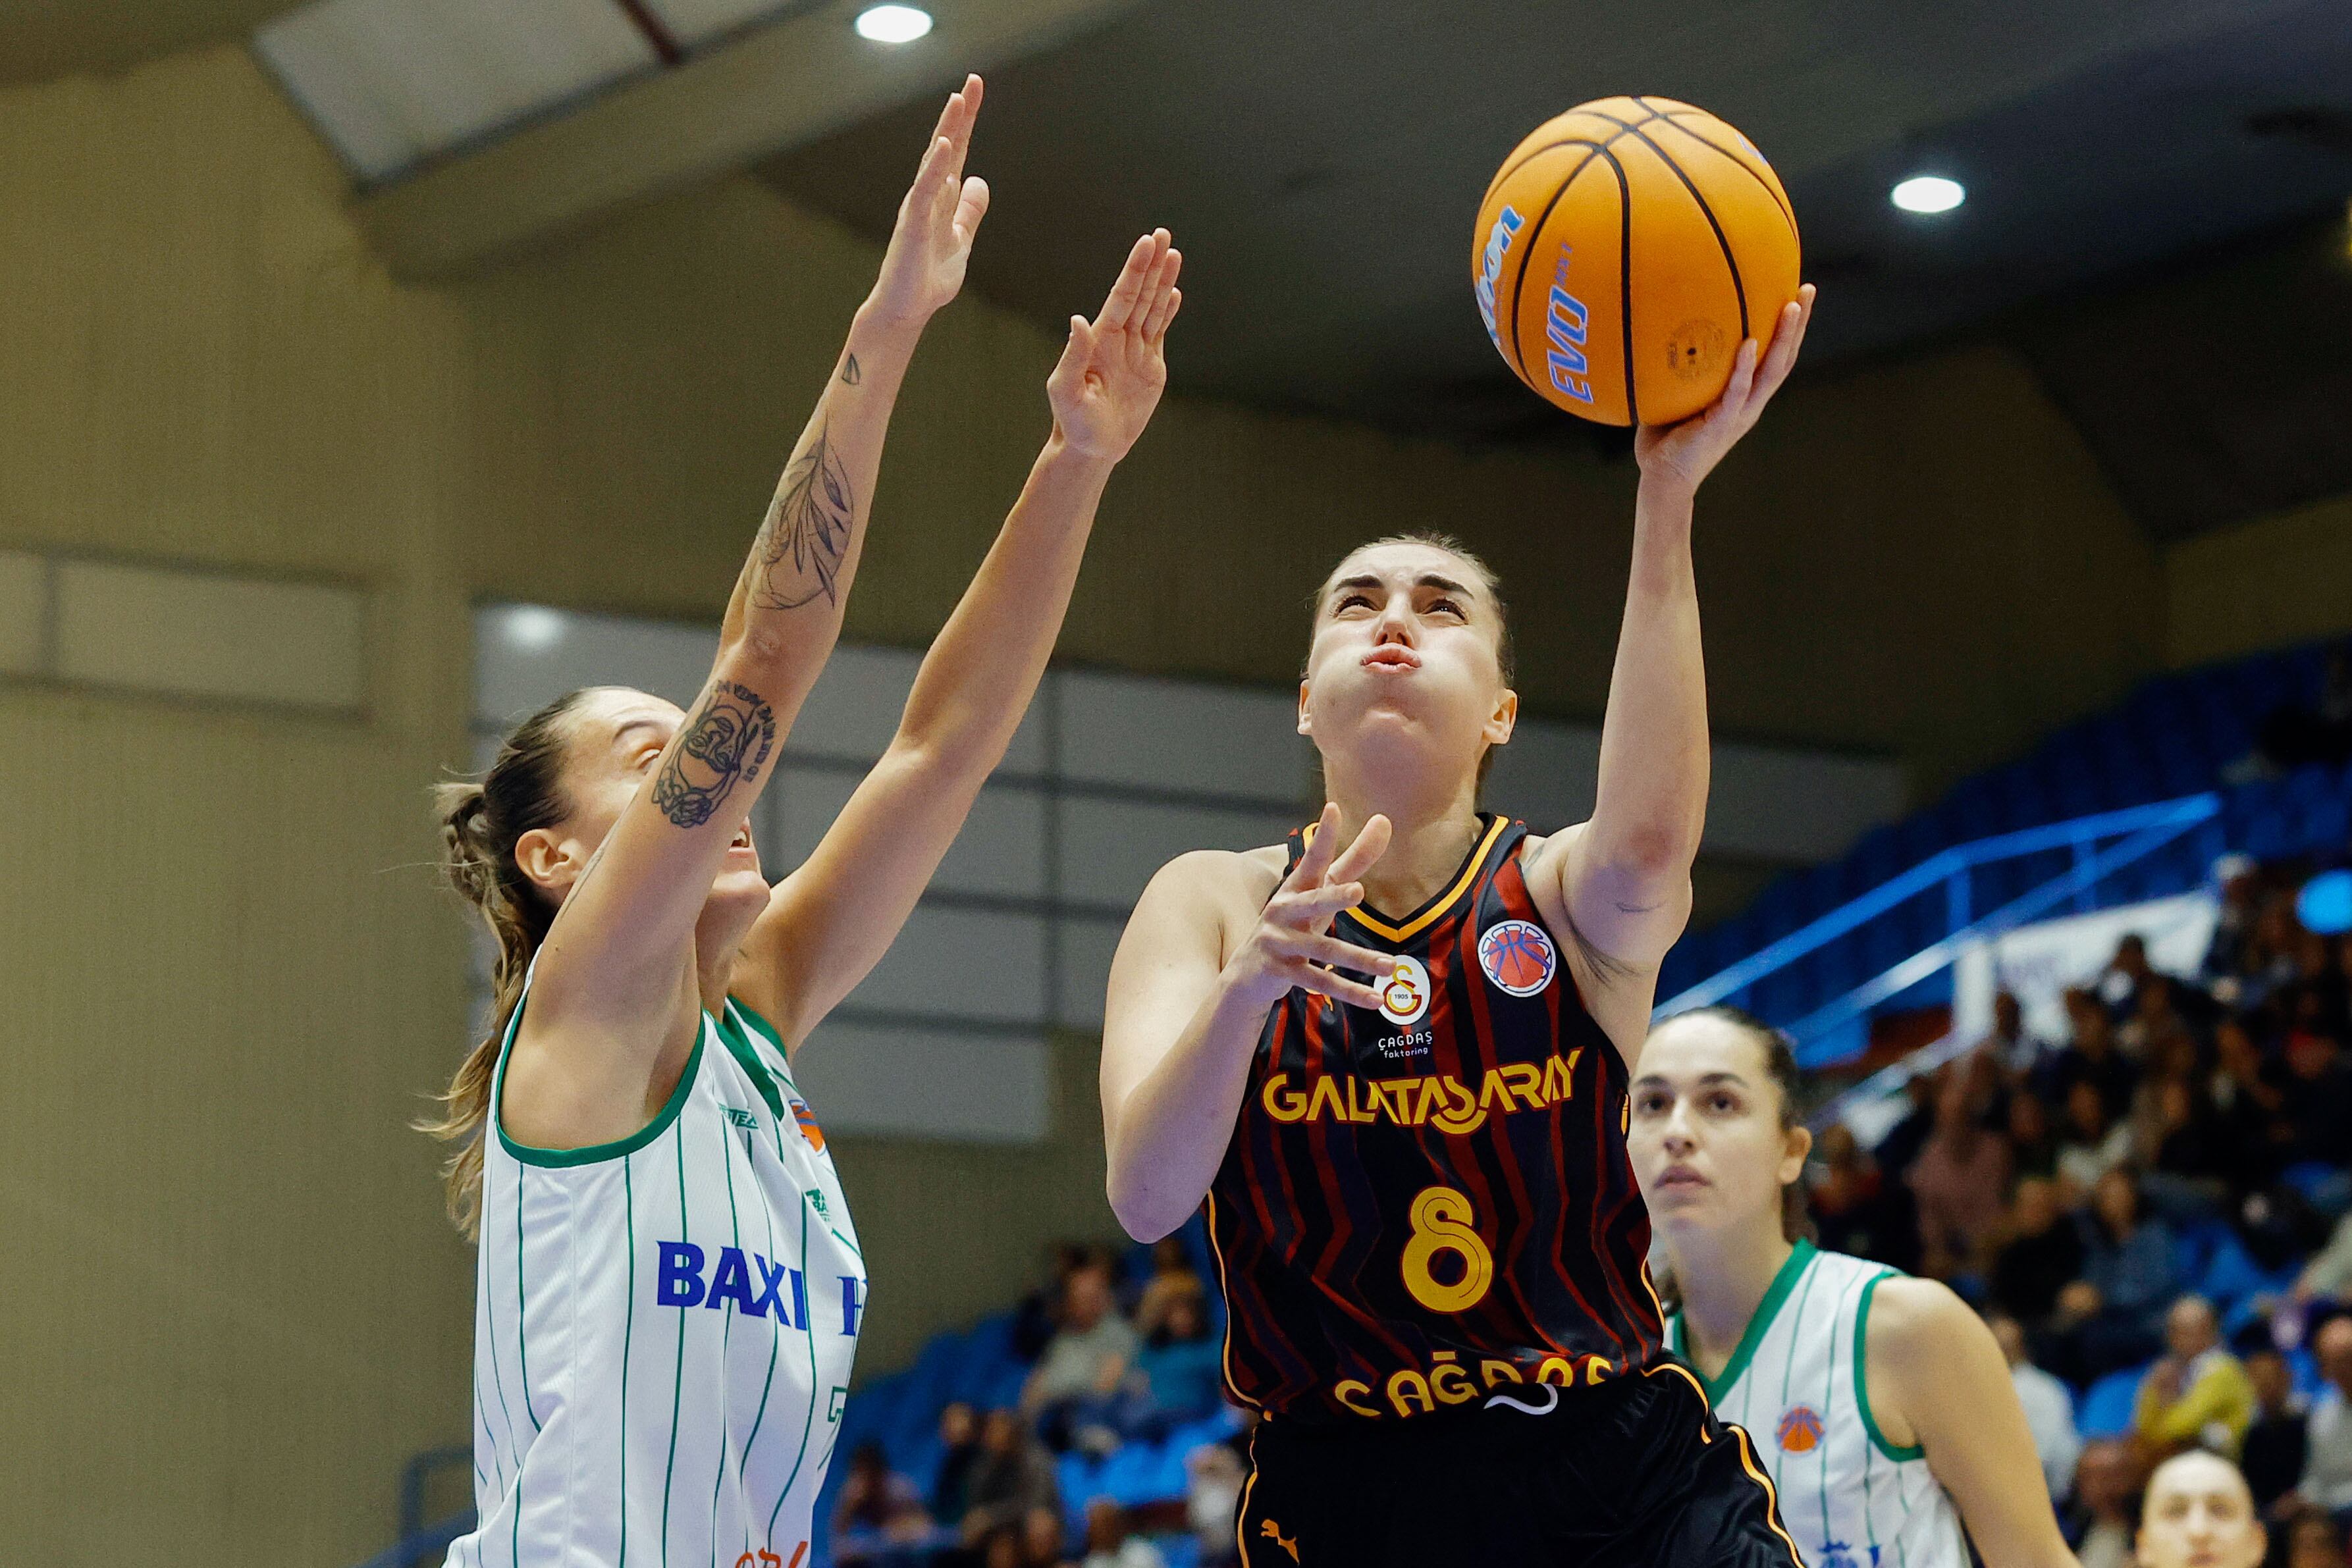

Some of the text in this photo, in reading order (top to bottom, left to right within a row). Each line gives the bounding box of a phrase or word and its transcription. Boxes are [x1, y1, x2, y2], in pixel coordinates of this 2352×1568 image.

[1547, 284, 1593, 404] EVO
[1262, 1048, 1583, 1136] GALATASARAY
[1383, 1047, 1429, 1058] faktoring
[656, 1240, 808, 1331] BAXI
[1401, 1186, 1494, 1314] 8
